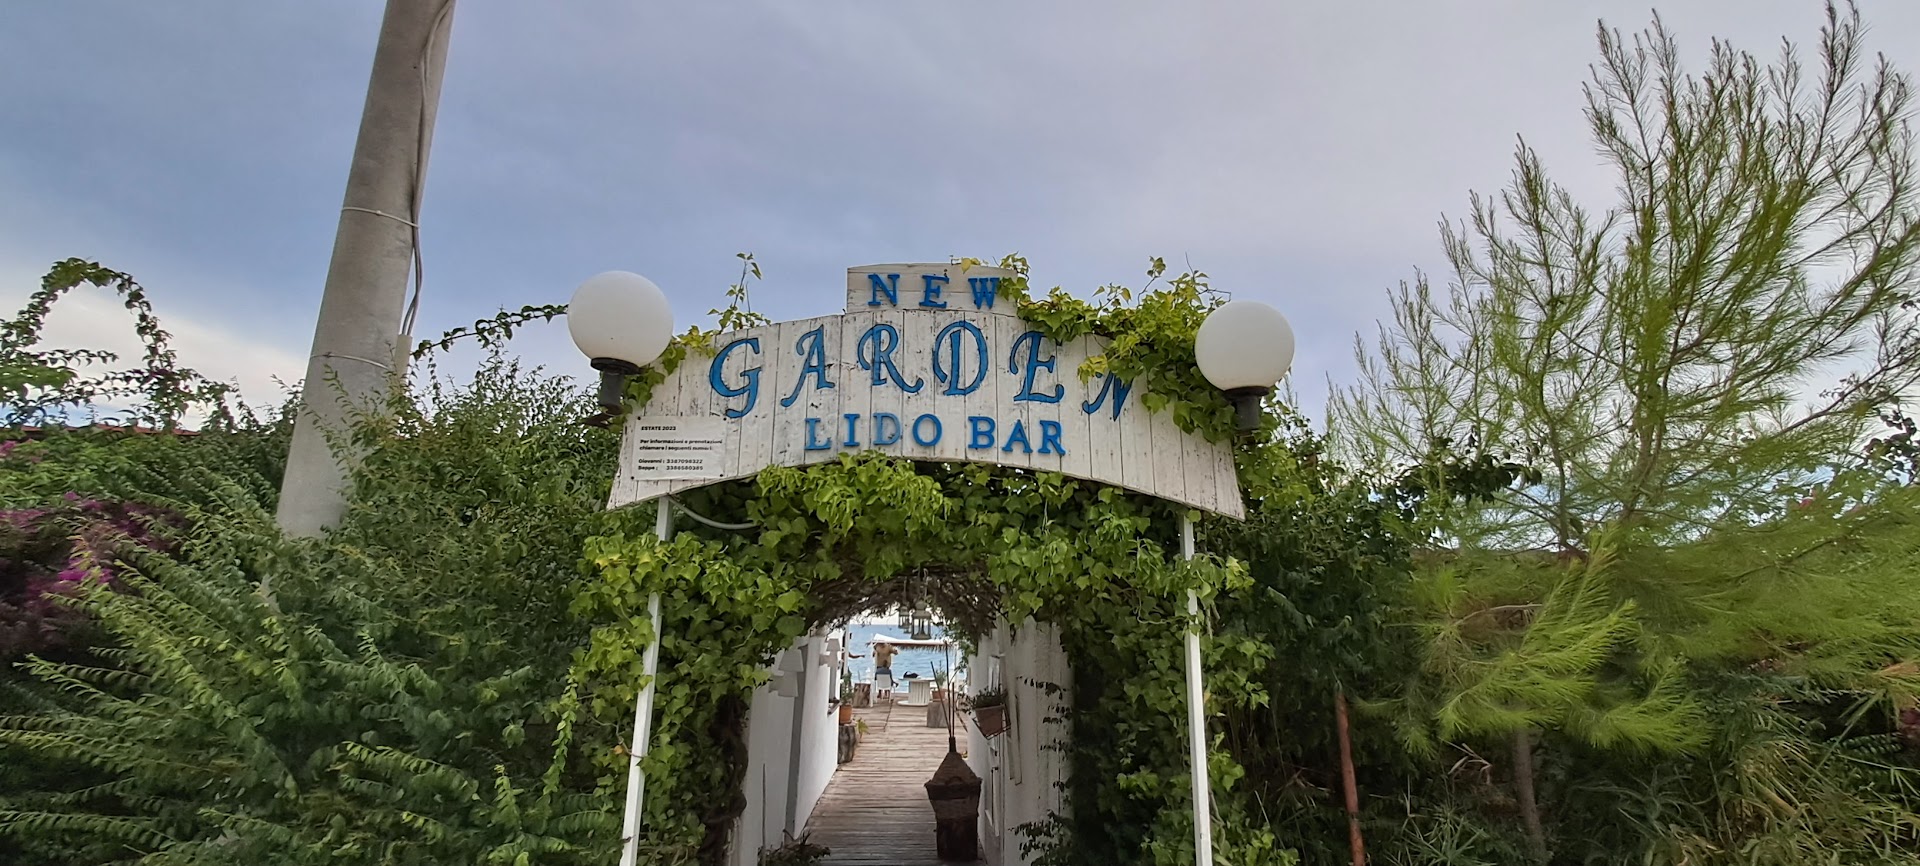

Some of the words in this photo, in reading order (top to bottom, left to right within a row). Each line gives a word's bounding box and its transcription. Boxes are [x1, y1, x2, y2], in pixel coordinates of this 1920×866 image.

[867, 273, 1000, 310] NEW
[709, 320, 1134, 422] GARDEN
[804, 412, 942, 450] LIDO
[968, 415, 1066, 456] BAR
